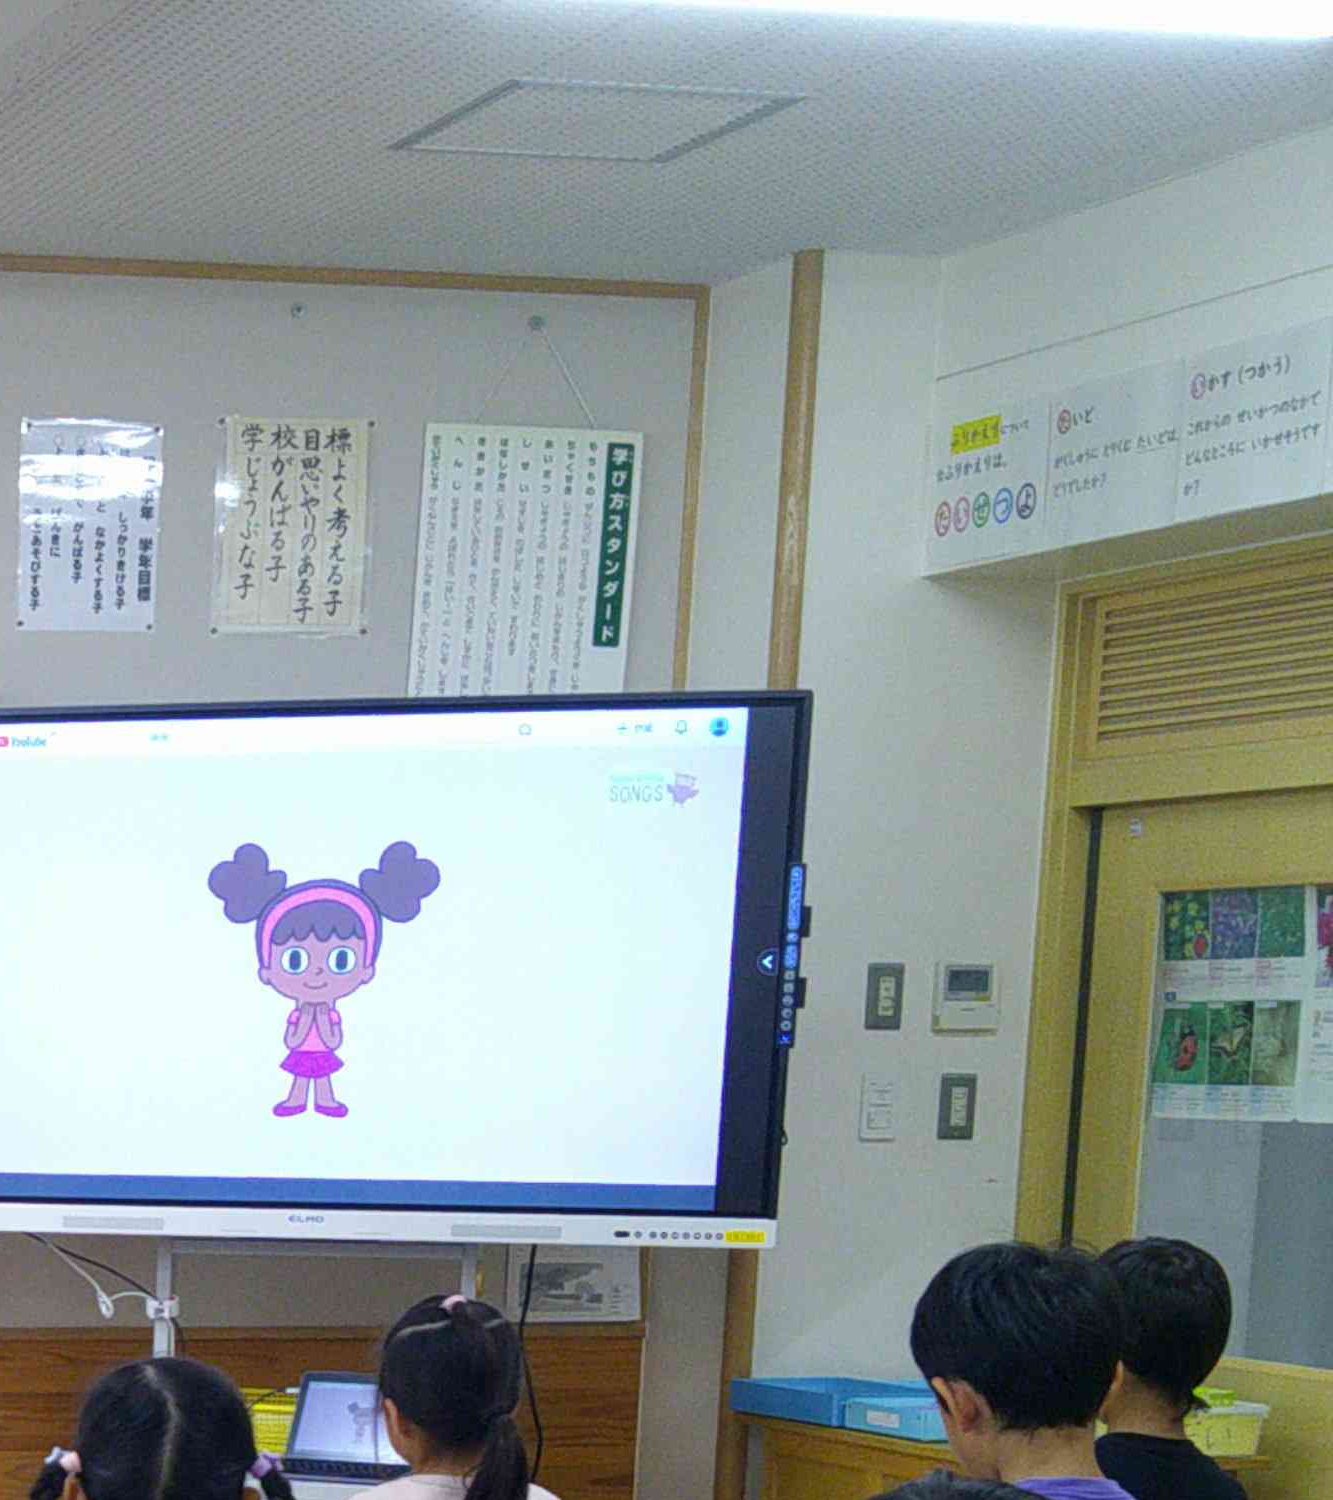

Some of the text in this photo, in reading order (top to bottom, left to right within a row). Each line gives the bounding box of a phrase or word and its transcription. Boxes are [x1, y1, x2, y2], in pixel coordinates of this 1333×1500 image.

[240, 423, 352, 455] 学校目標
[293, 456, 323, 624] 思いやりのある子
[324, 457, 351, 617] よく考える子
[609, 785, 664, 803] SONGS
